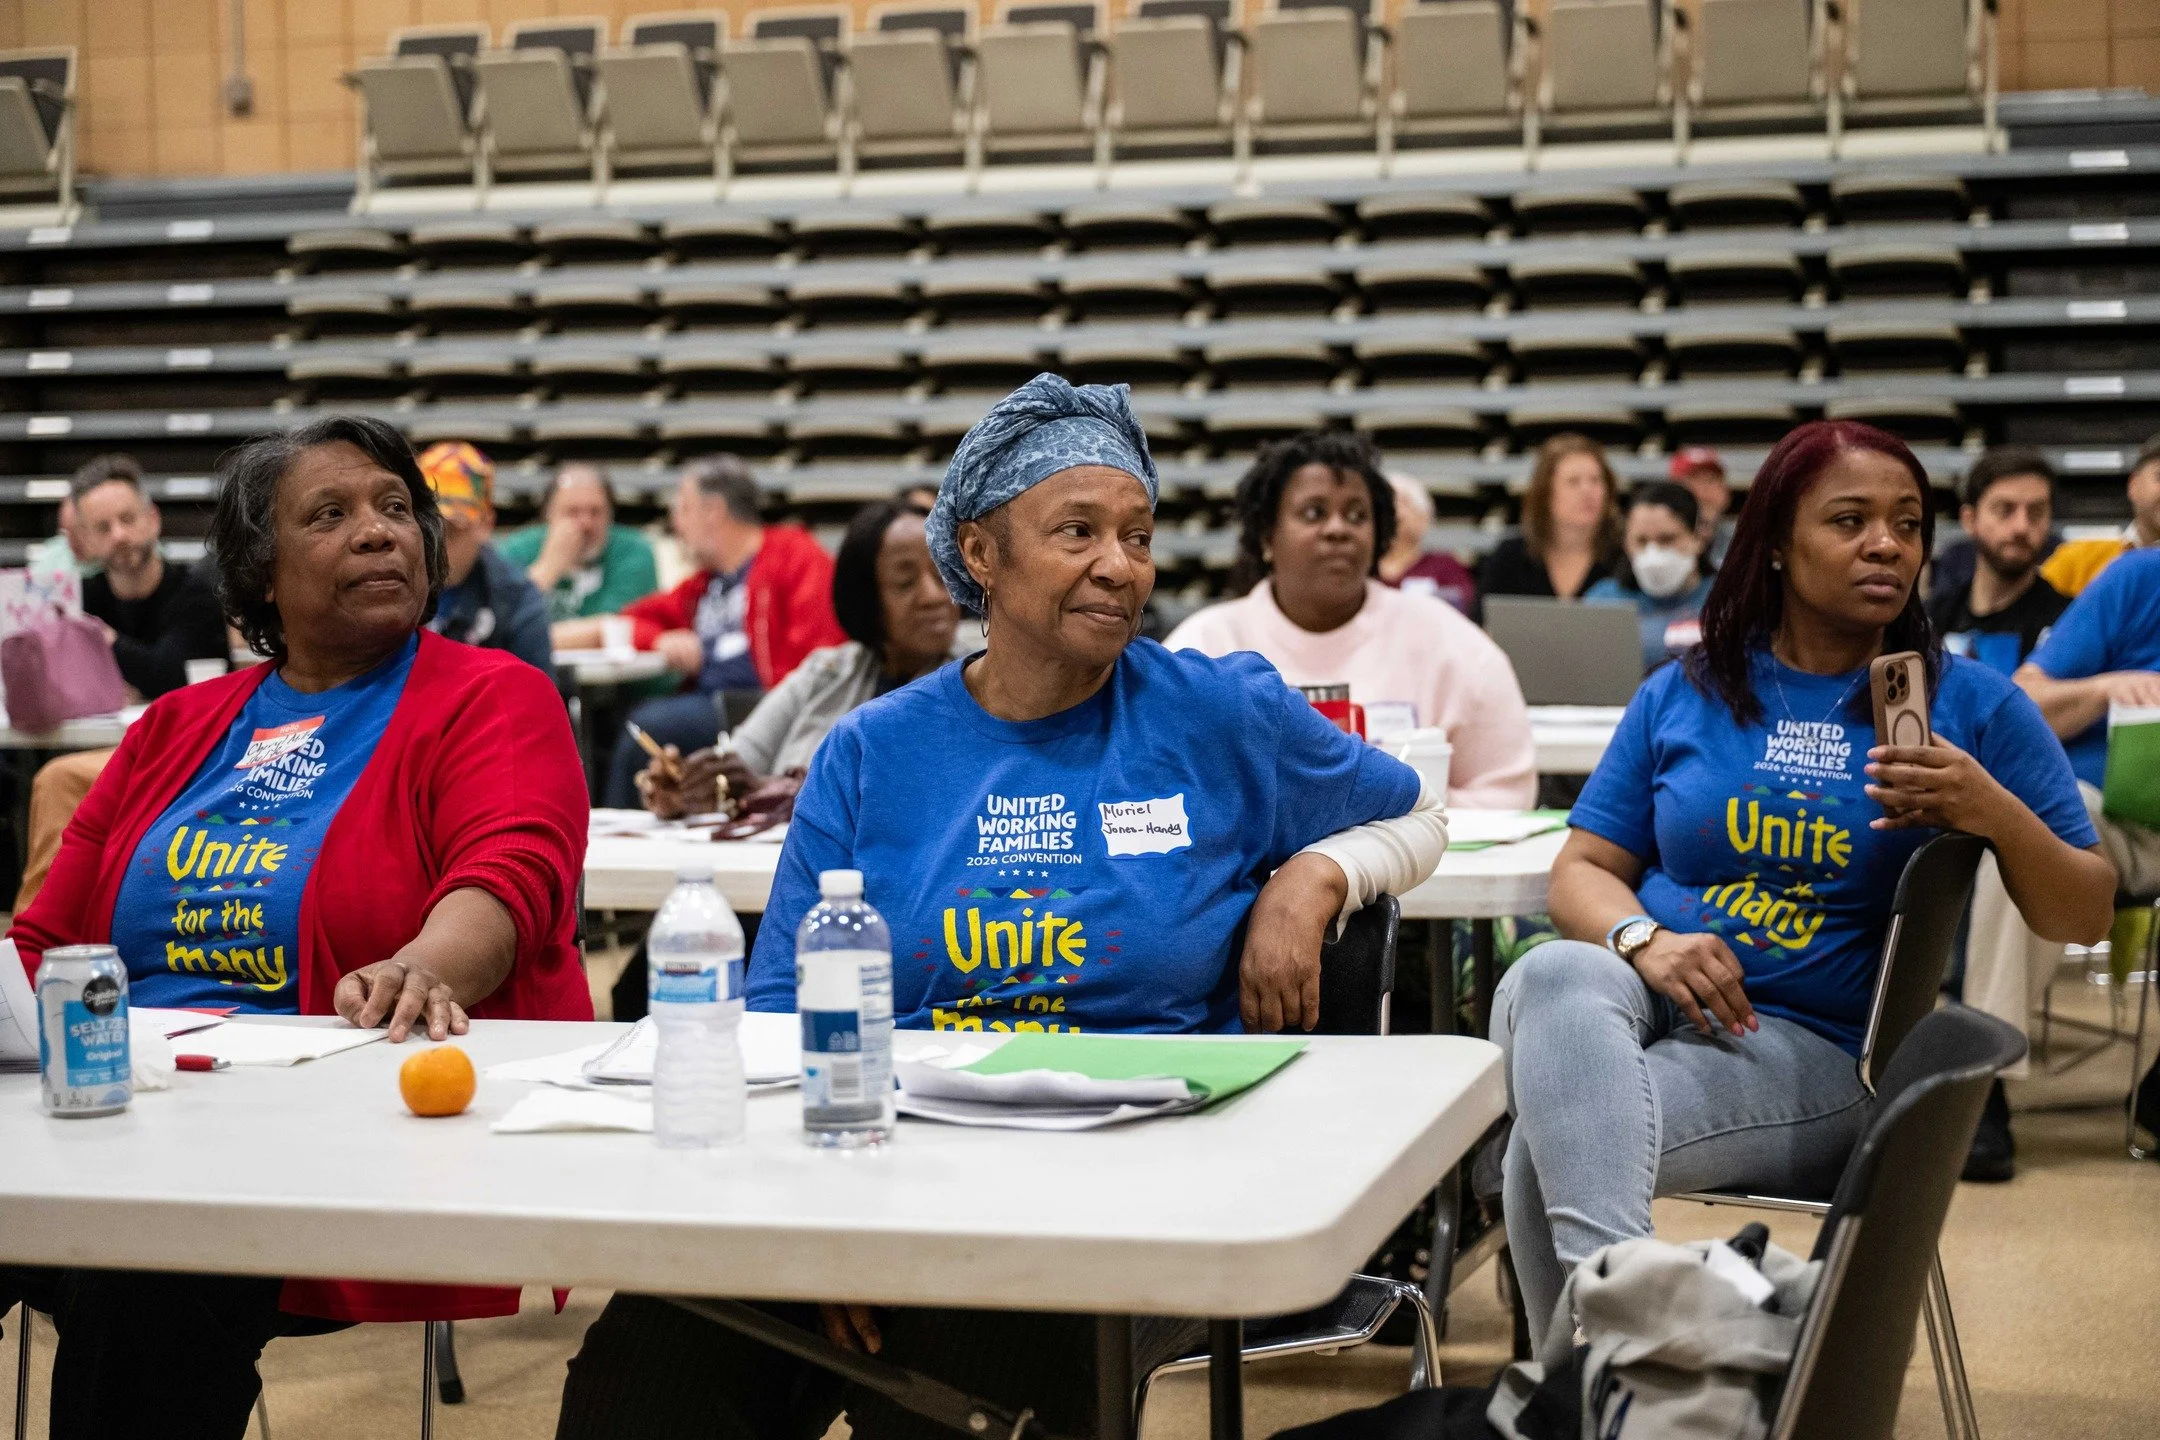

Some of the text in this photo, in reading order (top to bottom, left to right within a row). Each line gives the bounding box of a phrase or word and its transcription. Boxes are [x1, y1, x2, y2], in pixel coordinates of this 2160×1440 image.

[1777, 720, 1845, 740] UNITED
[1767, 734, 1851, 757] WORKING
[1753, 761, 1853, 781] 2026 CONVENTION
[1765, 748, 1847, 771] FAMILIES
[246, 786, 314, 802] CONVENTION
[987, 793, 1066, 816] UNITED
[1103, 803, 1152, 820] Muriel
[977, 811, 1077, 836] WORKING
[1727, 797, 1852, 868] Unite
[167, 826, 289, 881] Unite
[978, 831, 1074, 854] FAMILIES
[966, 853, 1082, 867] 2026 CONVENTION
[171, 898, 264, 936] for the
[1702, 880, 1826, 949] many
[943, 907, 1087, 974] Unite
